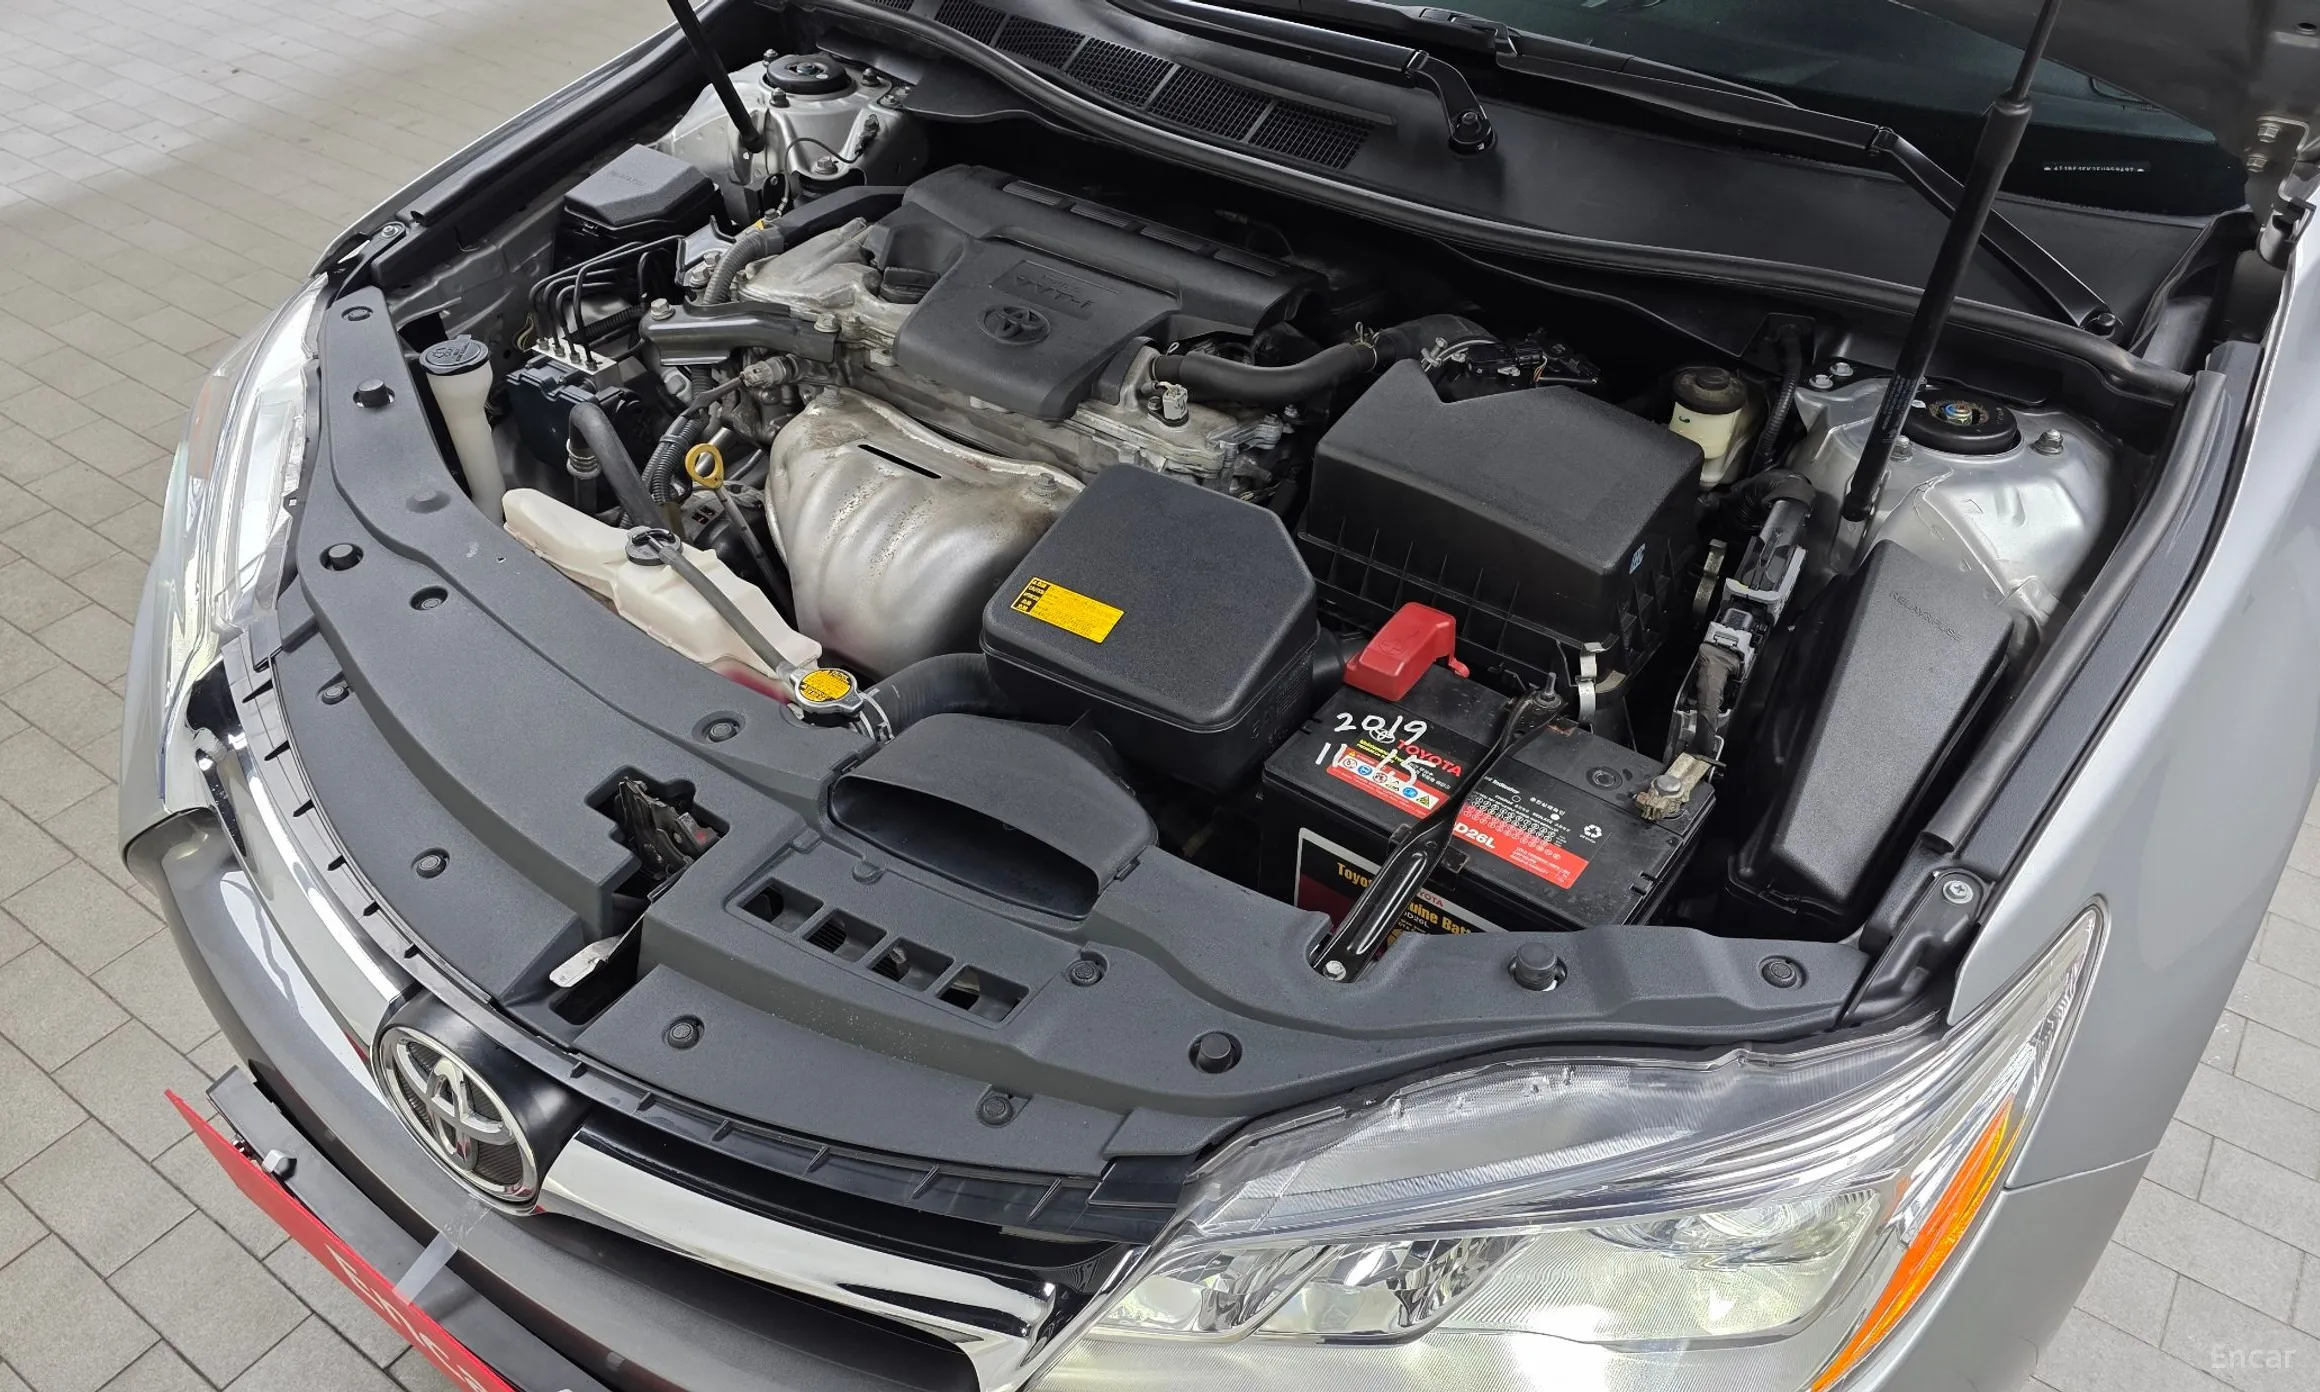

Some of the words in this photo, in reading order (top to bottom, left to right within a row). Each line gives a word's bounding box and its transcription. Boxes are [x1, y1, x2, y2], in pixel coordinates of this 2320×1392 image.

[1334, 712, 1428, 745] 2019
[1397, 739, 1462, 777] TOYOTA
[1454, 822, 1495, 849] D26L
[1336, 862, 1372, 888] Toyo
[1408, 902, 1438, 924] uine
